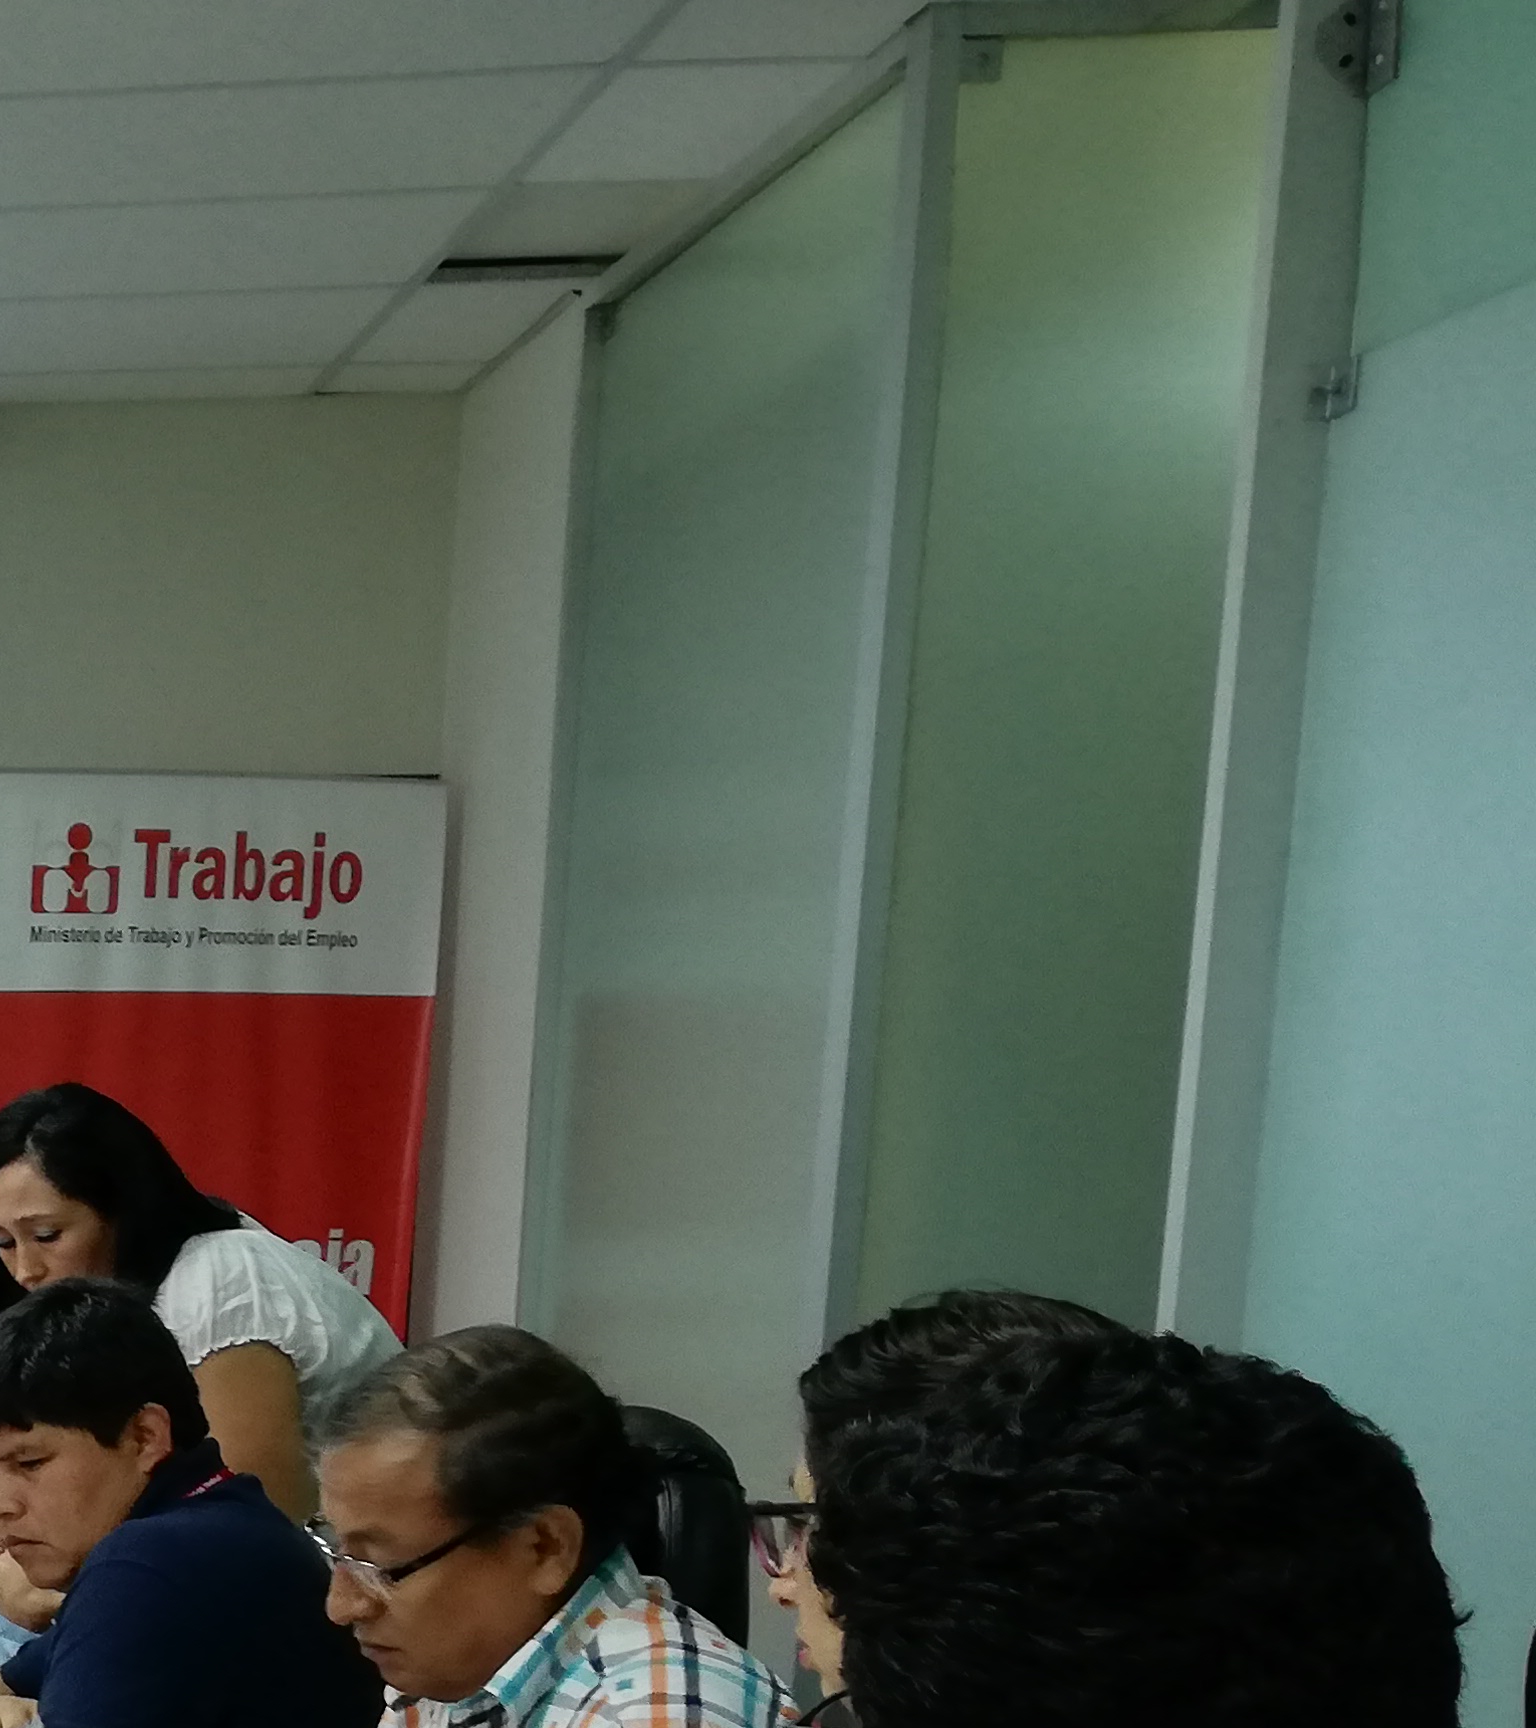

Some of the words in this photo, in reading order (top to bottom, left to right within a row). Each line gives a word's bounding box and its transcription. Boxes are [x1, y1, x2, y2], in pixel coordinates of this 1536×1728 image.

[134, 829, 363, 919] Trabajo
[29, 925, 101, 943] Ministerio
[104, 926, 123, 943] de
[129, 926, 182, 948] Trabajo
[185, 930, 195, 948] y
[199, 927, 275, 945] Promoción
[279, 929, 303, 946] del
[306, 929, 358, 949] Empleo
